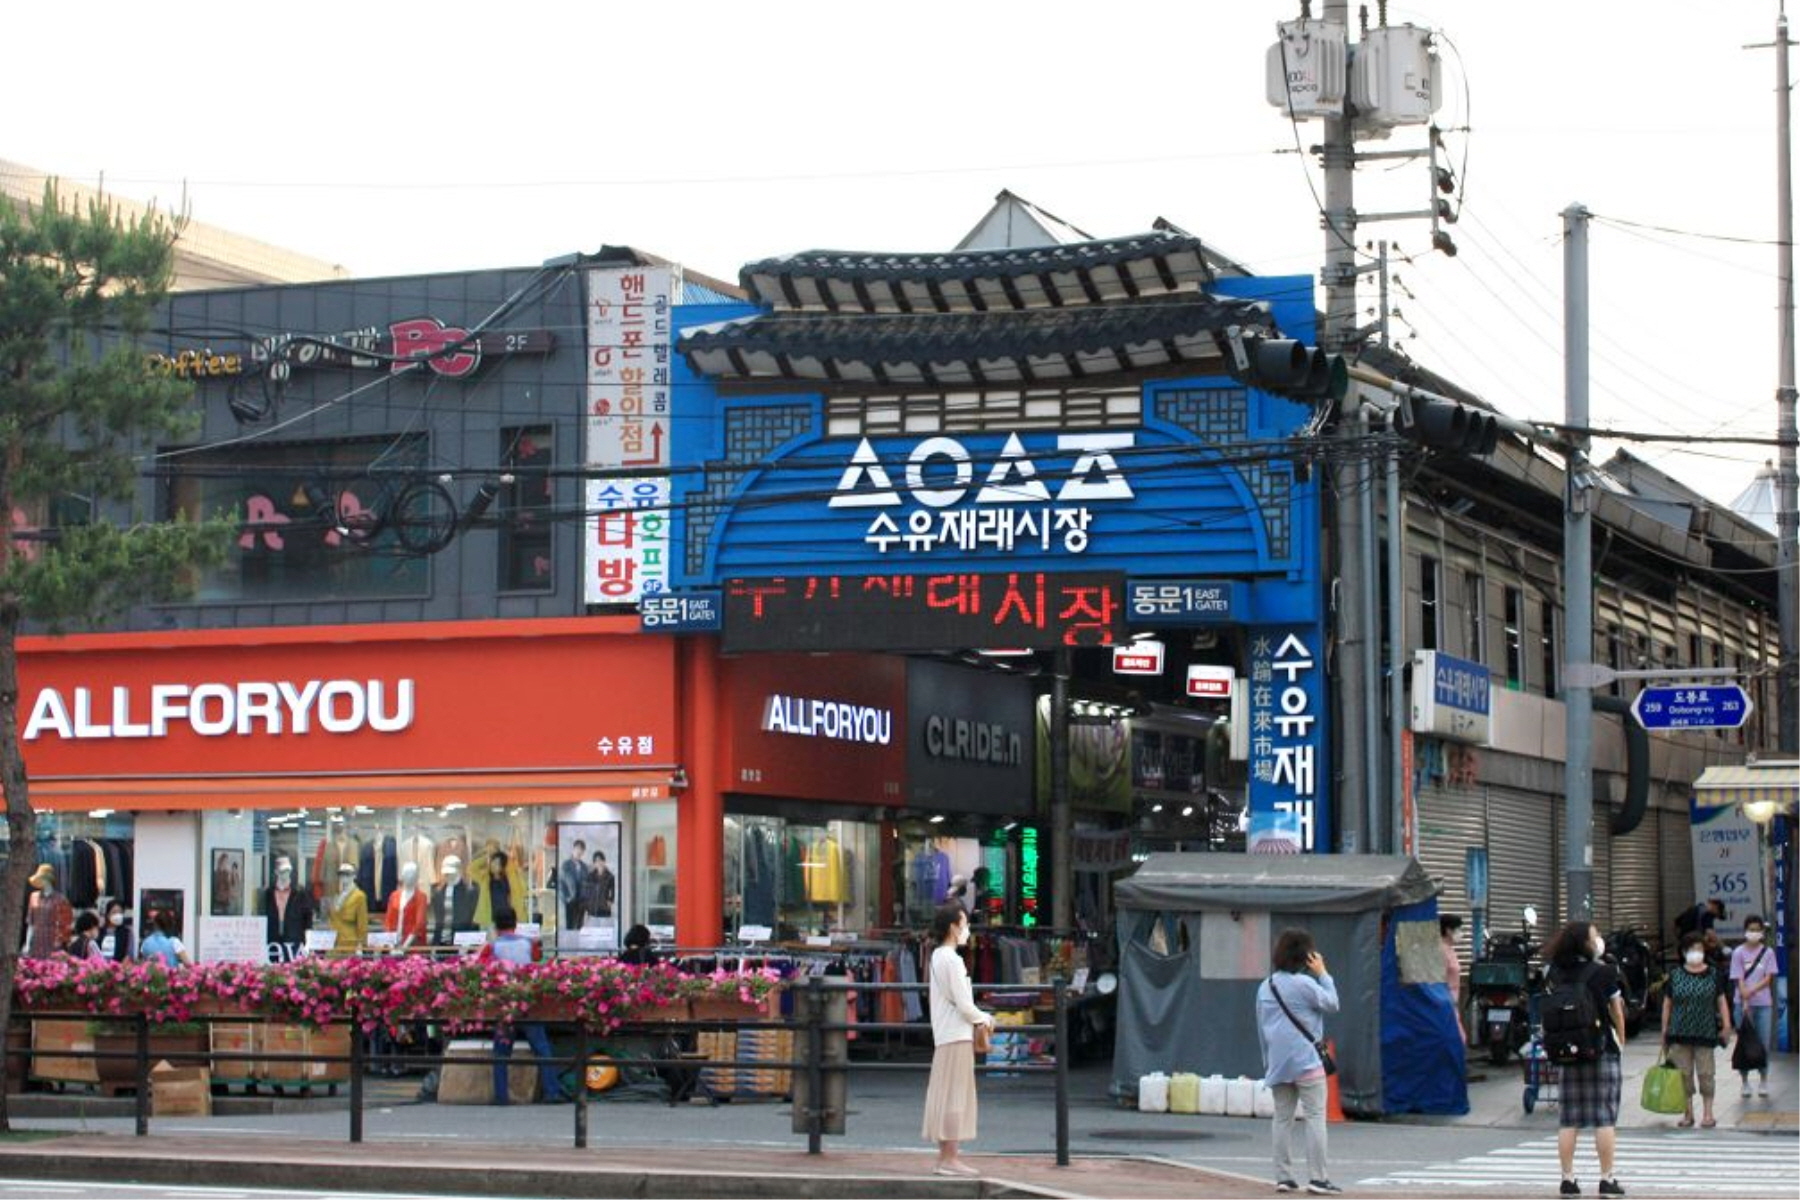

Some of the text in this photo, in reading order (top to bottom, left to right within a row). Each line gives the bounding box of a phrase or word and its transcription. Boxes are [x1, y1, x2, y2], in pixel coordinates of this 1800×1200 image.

[506, 335, 528, 351] 2F
[619, 274, 645, 453] 핸드폰 할인점
[598, 483, 660, 508] 수유
[864, 507, 1092, 554] 수유재래시장
[598, 508, 637, 597] 다방
[641, 514, 662, 576] 호프
[689, 600, 710, 609] EAST
[1132, 586, 1193, 614] 동문1
[1195, 588, 1219, 599] EAST
[1195, 600, 1228, 611] GATE1
[641, 598, 687, 626] 동문1
[689, 610, 716, 620] GATE1
[22, 678, 414, 739] ALLFORYOU
[1673, 690, 1709, 704] 도봉로
[762, 694, 891, 744] ALLFORYOU
[597, 735, 654, 756] 수유점
[926, 715, 1022, 765] CLRIDE.n
[1709, 872, 1748, 894] 365
